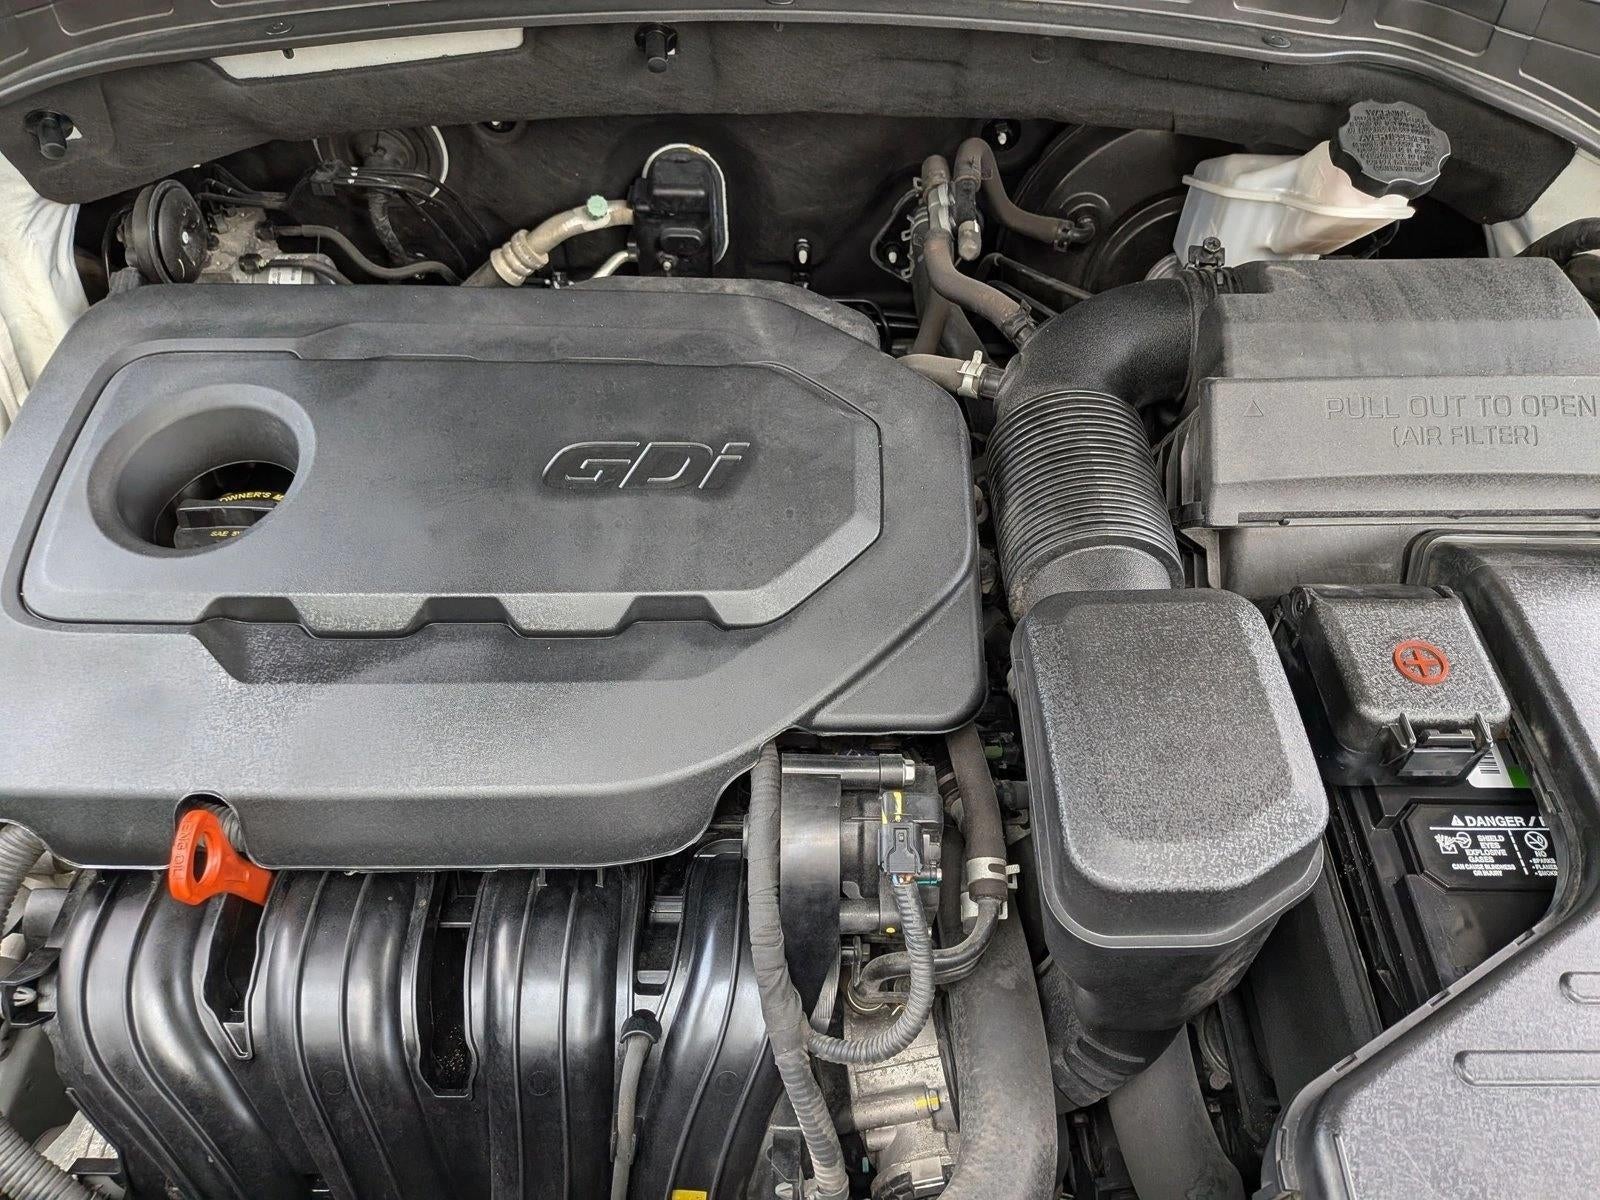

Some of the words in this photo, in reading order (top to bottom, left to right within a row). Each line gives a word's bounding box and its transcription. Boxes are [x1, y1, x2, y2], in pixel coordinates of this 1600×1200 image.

[1324, 396, 1400, 420] PULL
[1408, 395, 1466, 419] OUT
[1474, 395, 1512, 418] TO
[1519, 394, 1598, 418] OPEN
[1391, 424, 1442, 447] (AIR
[1450, 424, 1539, 447] FILTER)
[541, 440, 751, 490] GDi
[219, 491, 272, 503] OWNER'S
[1464, 815, 1526, 827] DANGER
[1534, 850, 1548, 858] NO
